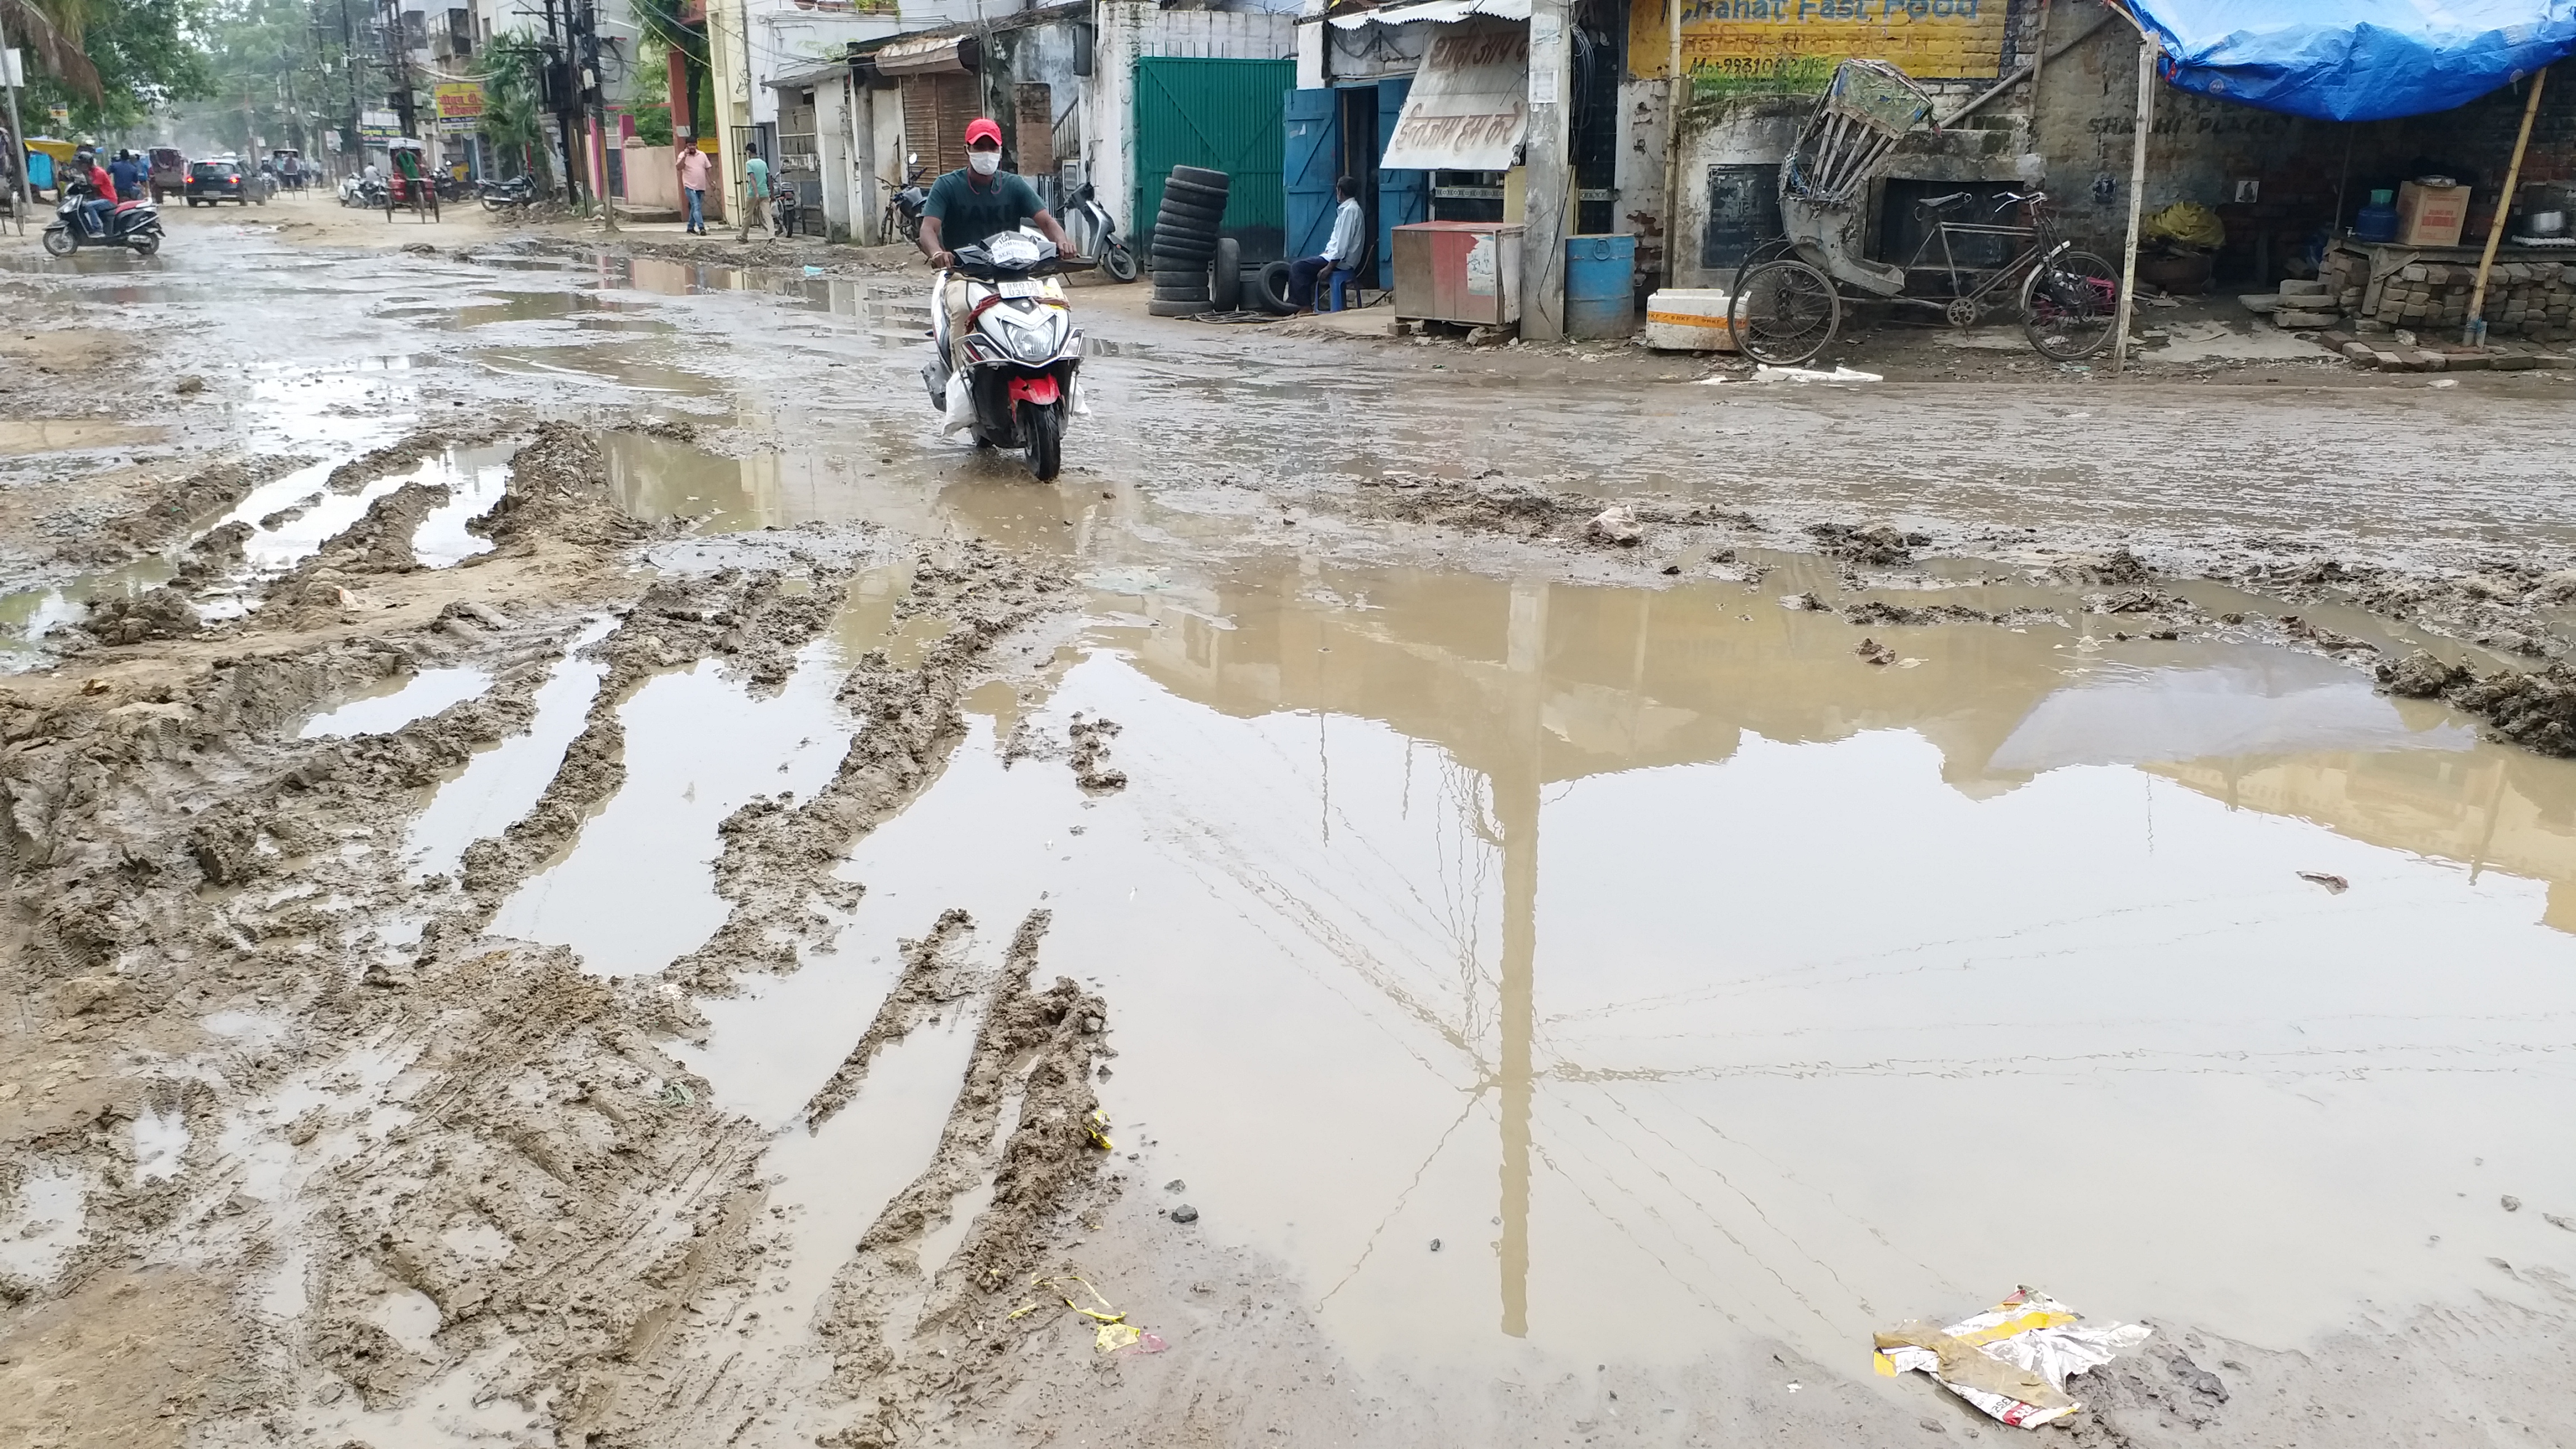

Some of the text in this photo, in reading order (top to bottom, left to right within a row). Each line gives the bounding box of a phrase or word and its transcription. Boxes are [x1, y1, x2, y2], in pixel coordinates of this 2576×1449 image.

[1798, 0, 1868, 20] Fast
[1882, 0, 1979, 19] Food
[1429, 24, 1476, 72] शादी
[1472, 31, 1516, 65] आप
[1453, 115, 1493, 153] हम
[2088, 117, 2181, 135] SHAHI
